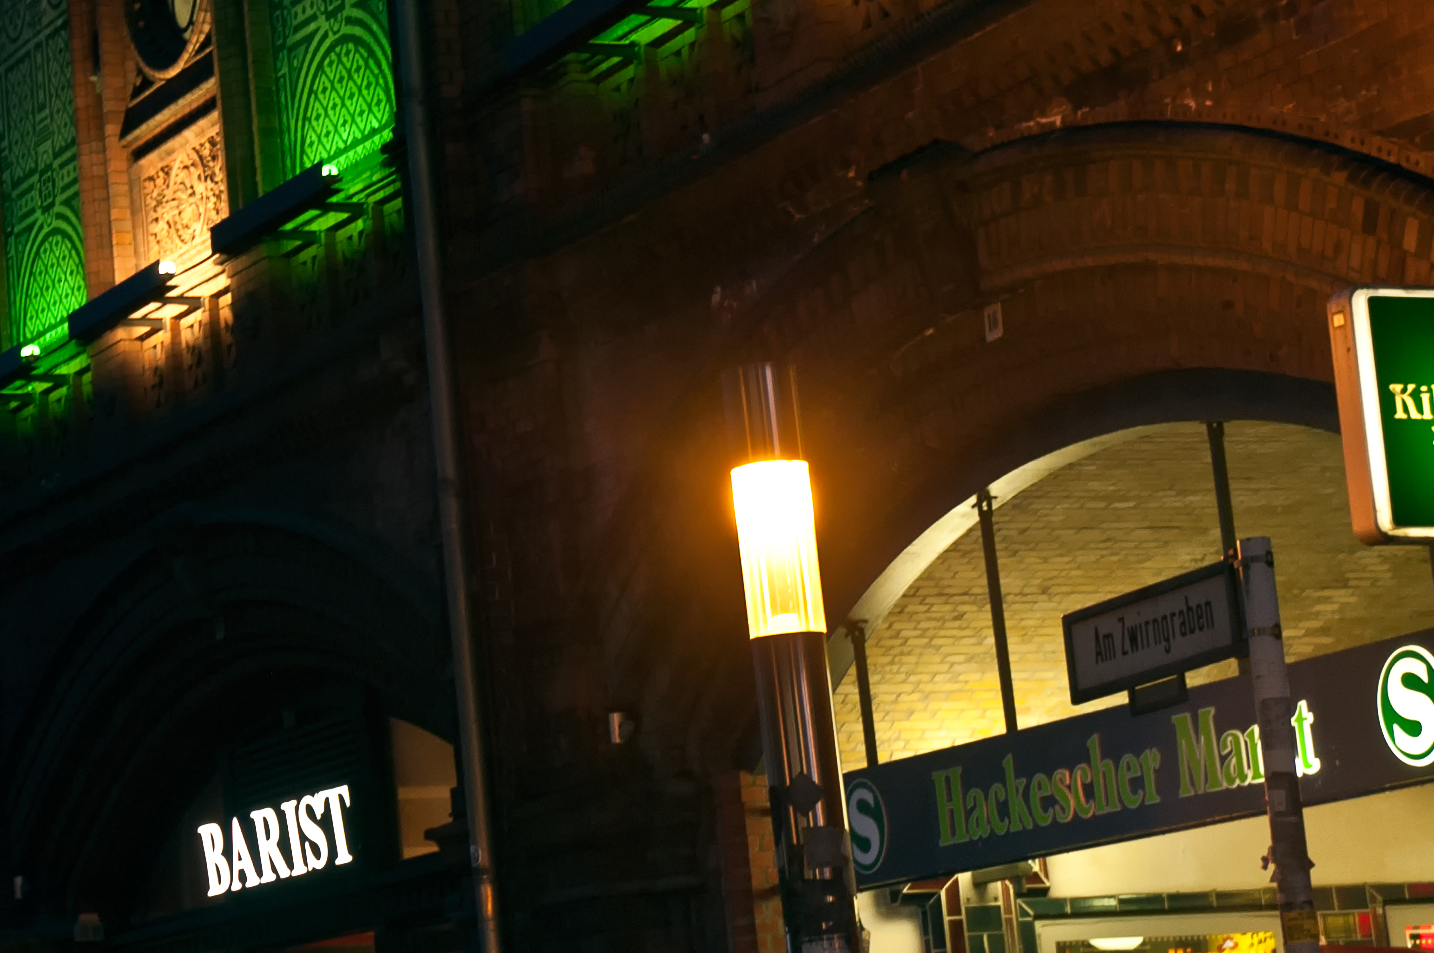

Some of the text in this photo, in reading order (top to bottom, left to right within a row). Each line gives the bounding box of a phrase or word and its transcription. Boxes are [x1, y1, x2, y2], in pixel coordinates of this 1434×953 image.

[1389, 383, 1434, 420] Ki
[1094, 595, 1215, 664] Am Zwirngraben
[847, 657, 1434, 865] S Hackescher Mart S
[197, 784, 353, 897] BARIST
